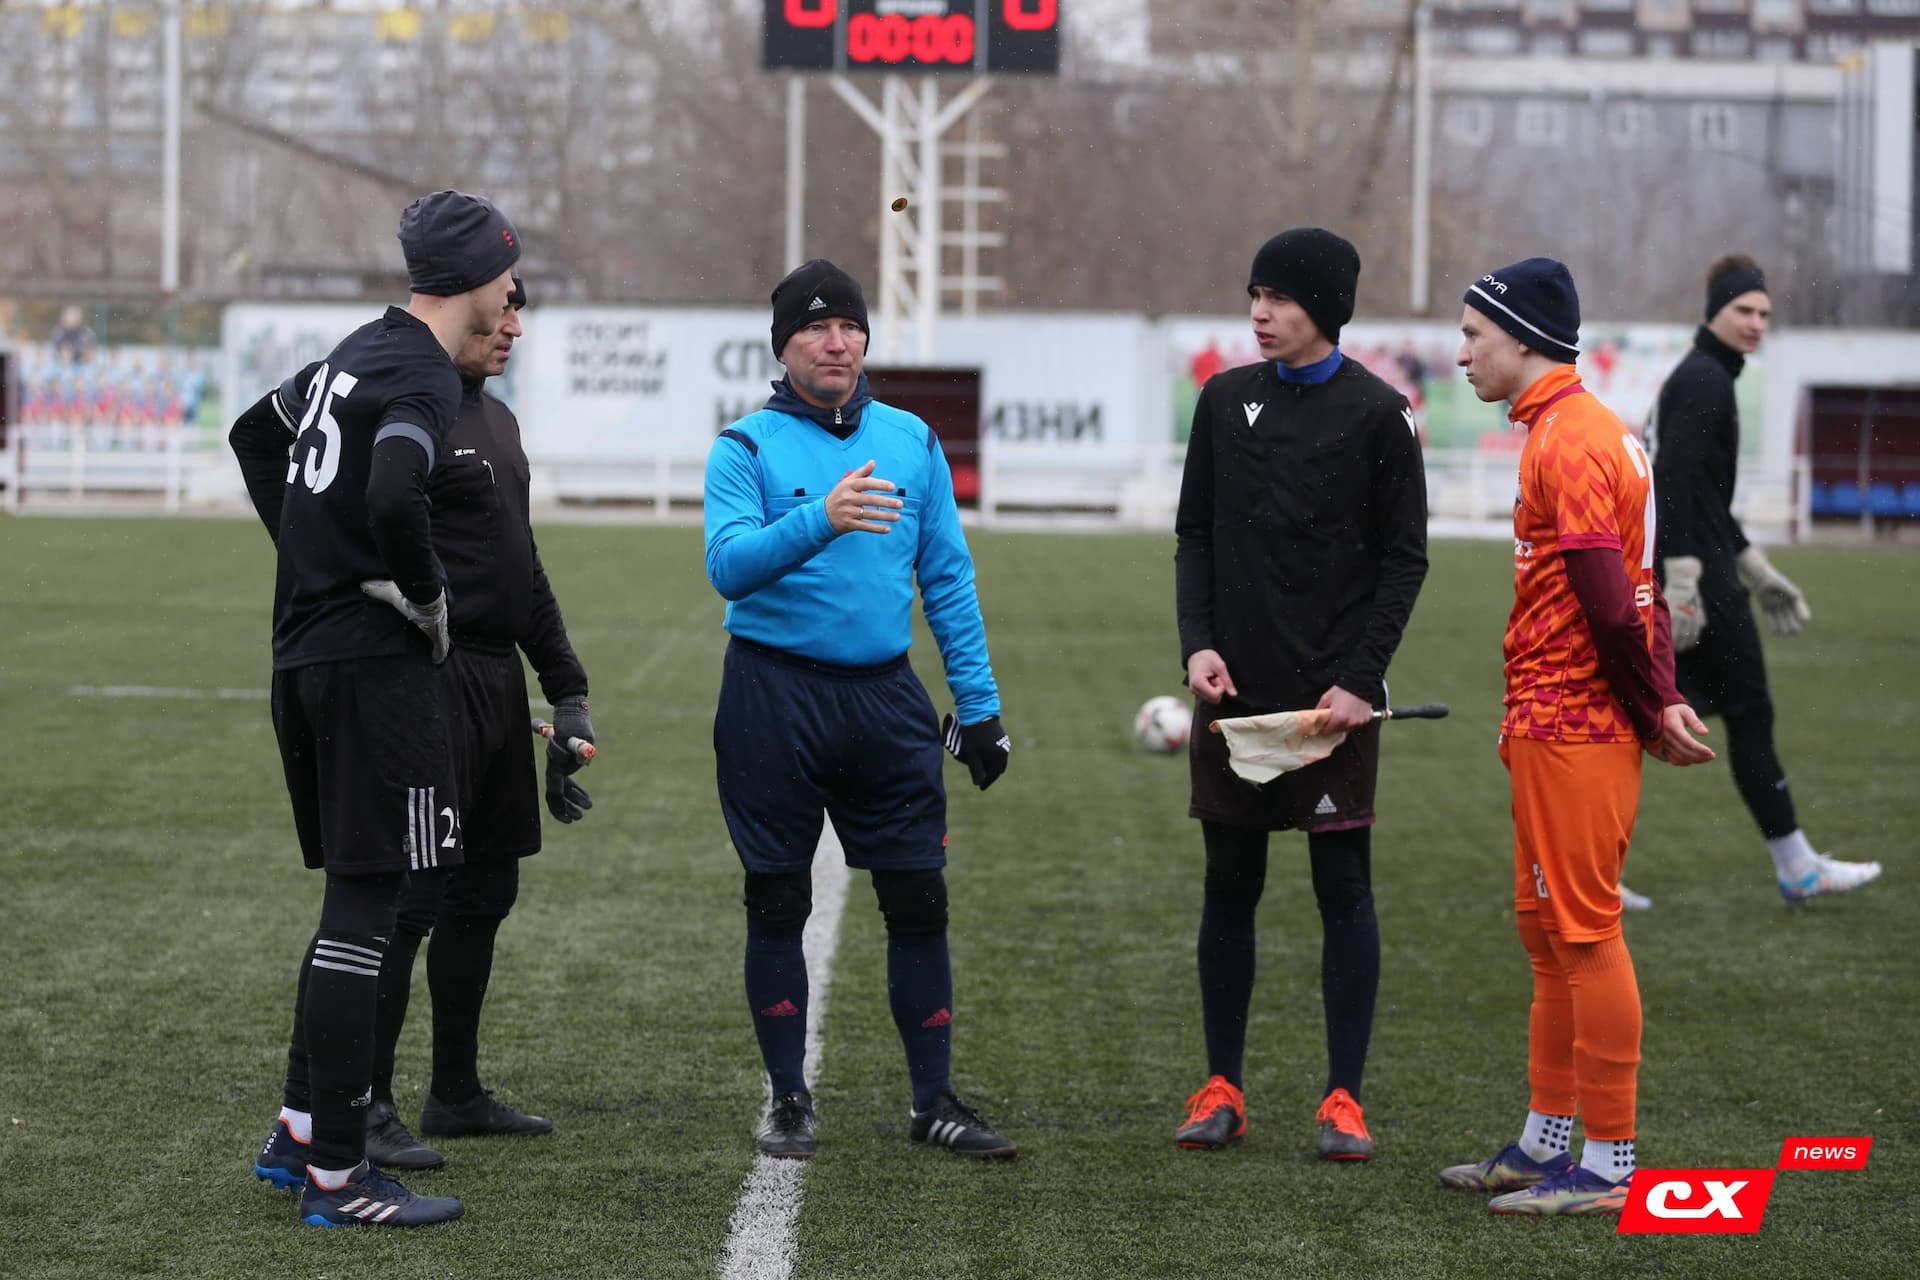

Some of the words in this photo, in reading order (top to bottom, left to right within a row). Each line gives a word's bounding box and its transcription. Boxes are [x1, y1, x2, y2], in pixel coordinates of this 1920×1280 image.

[847, 12, 975, 64] 00:00
[286, 363, 359, 494] 25
[263, 1131, 278, 1155] COPA
